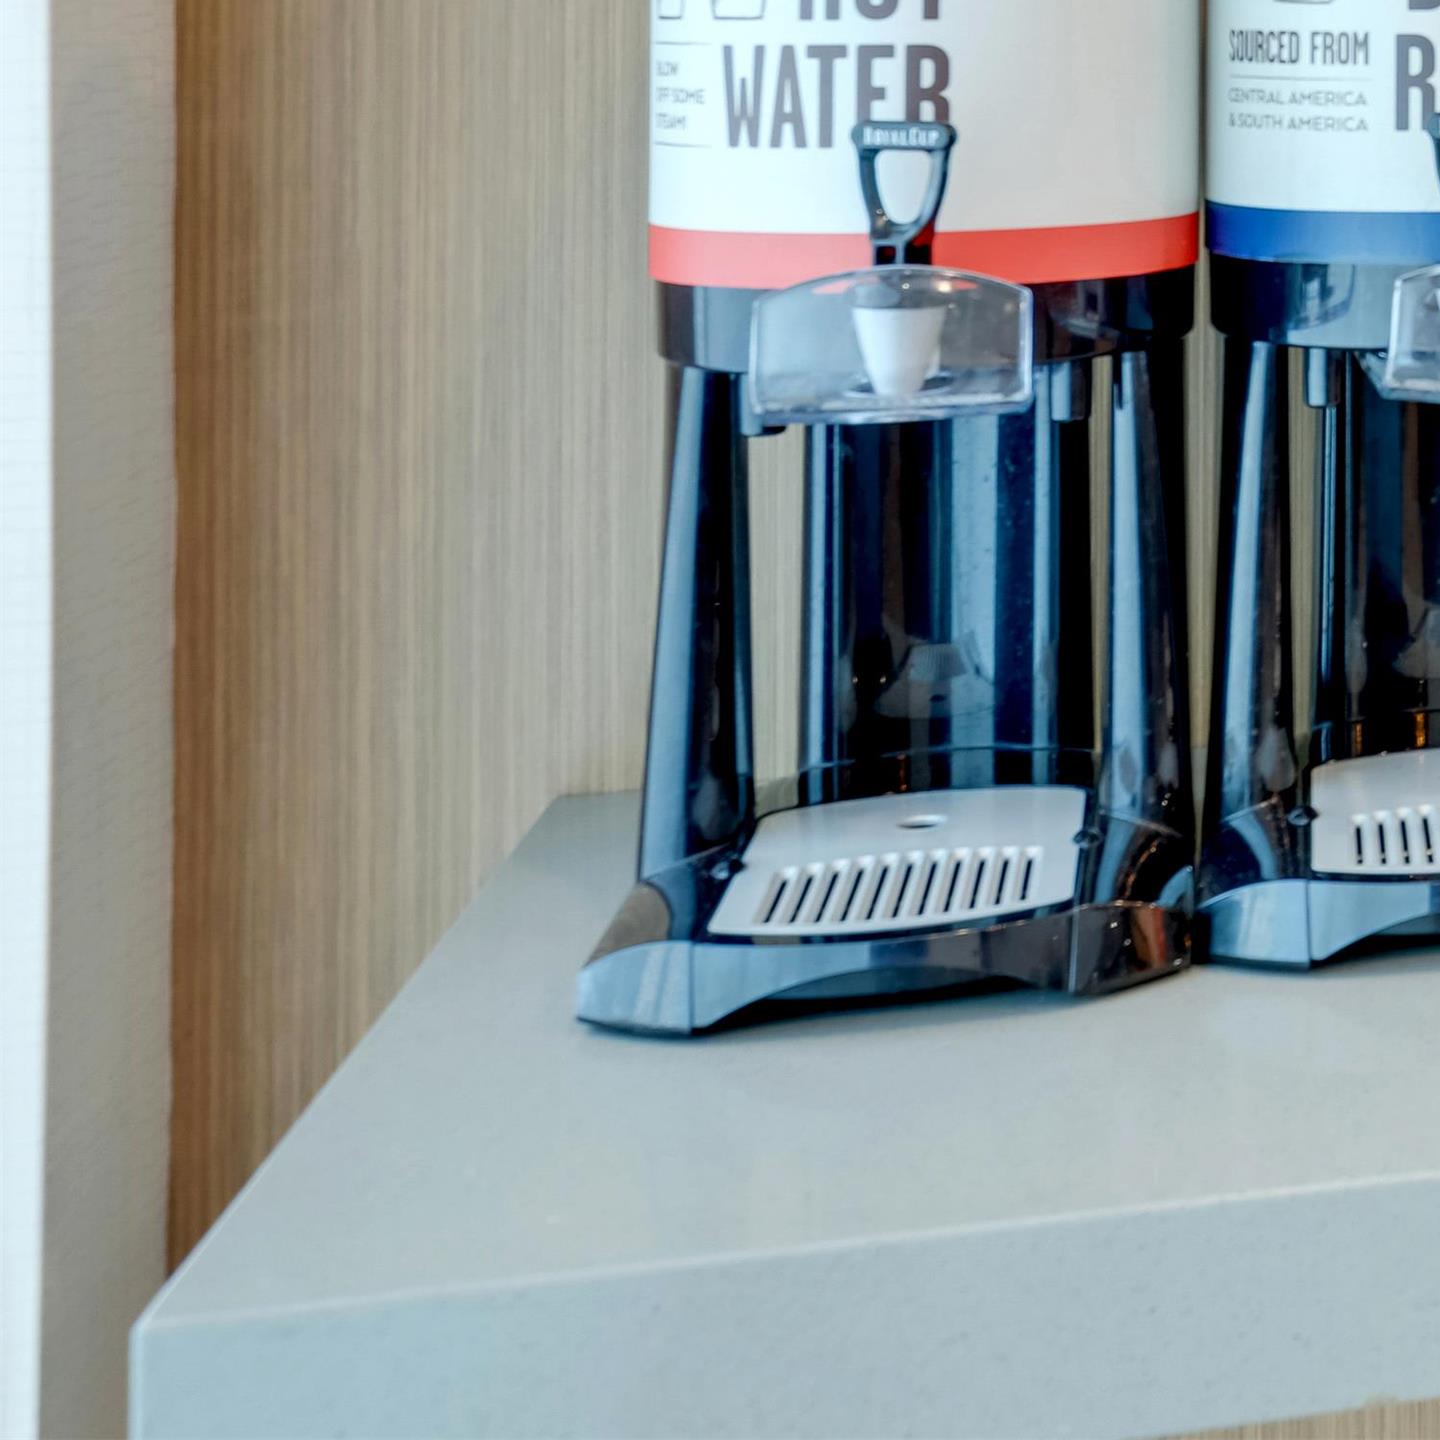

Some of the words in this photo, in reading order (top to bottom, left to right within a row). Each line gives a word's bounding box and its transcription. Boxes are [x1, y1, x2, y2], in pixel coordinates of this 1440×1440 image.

[1228, 29, 1300, 64] SOURCED
[1310, 31, 1370, 65] FROM
[722, 45, 951, 148] WATER
[1228, 87, 1284, 106] CENTRAL
[1288, 89, 1367, 107] AMERICA
[1235, 114, 1282, 130] SOUTH
[1287, 116, 1368, 132] AMERICA
